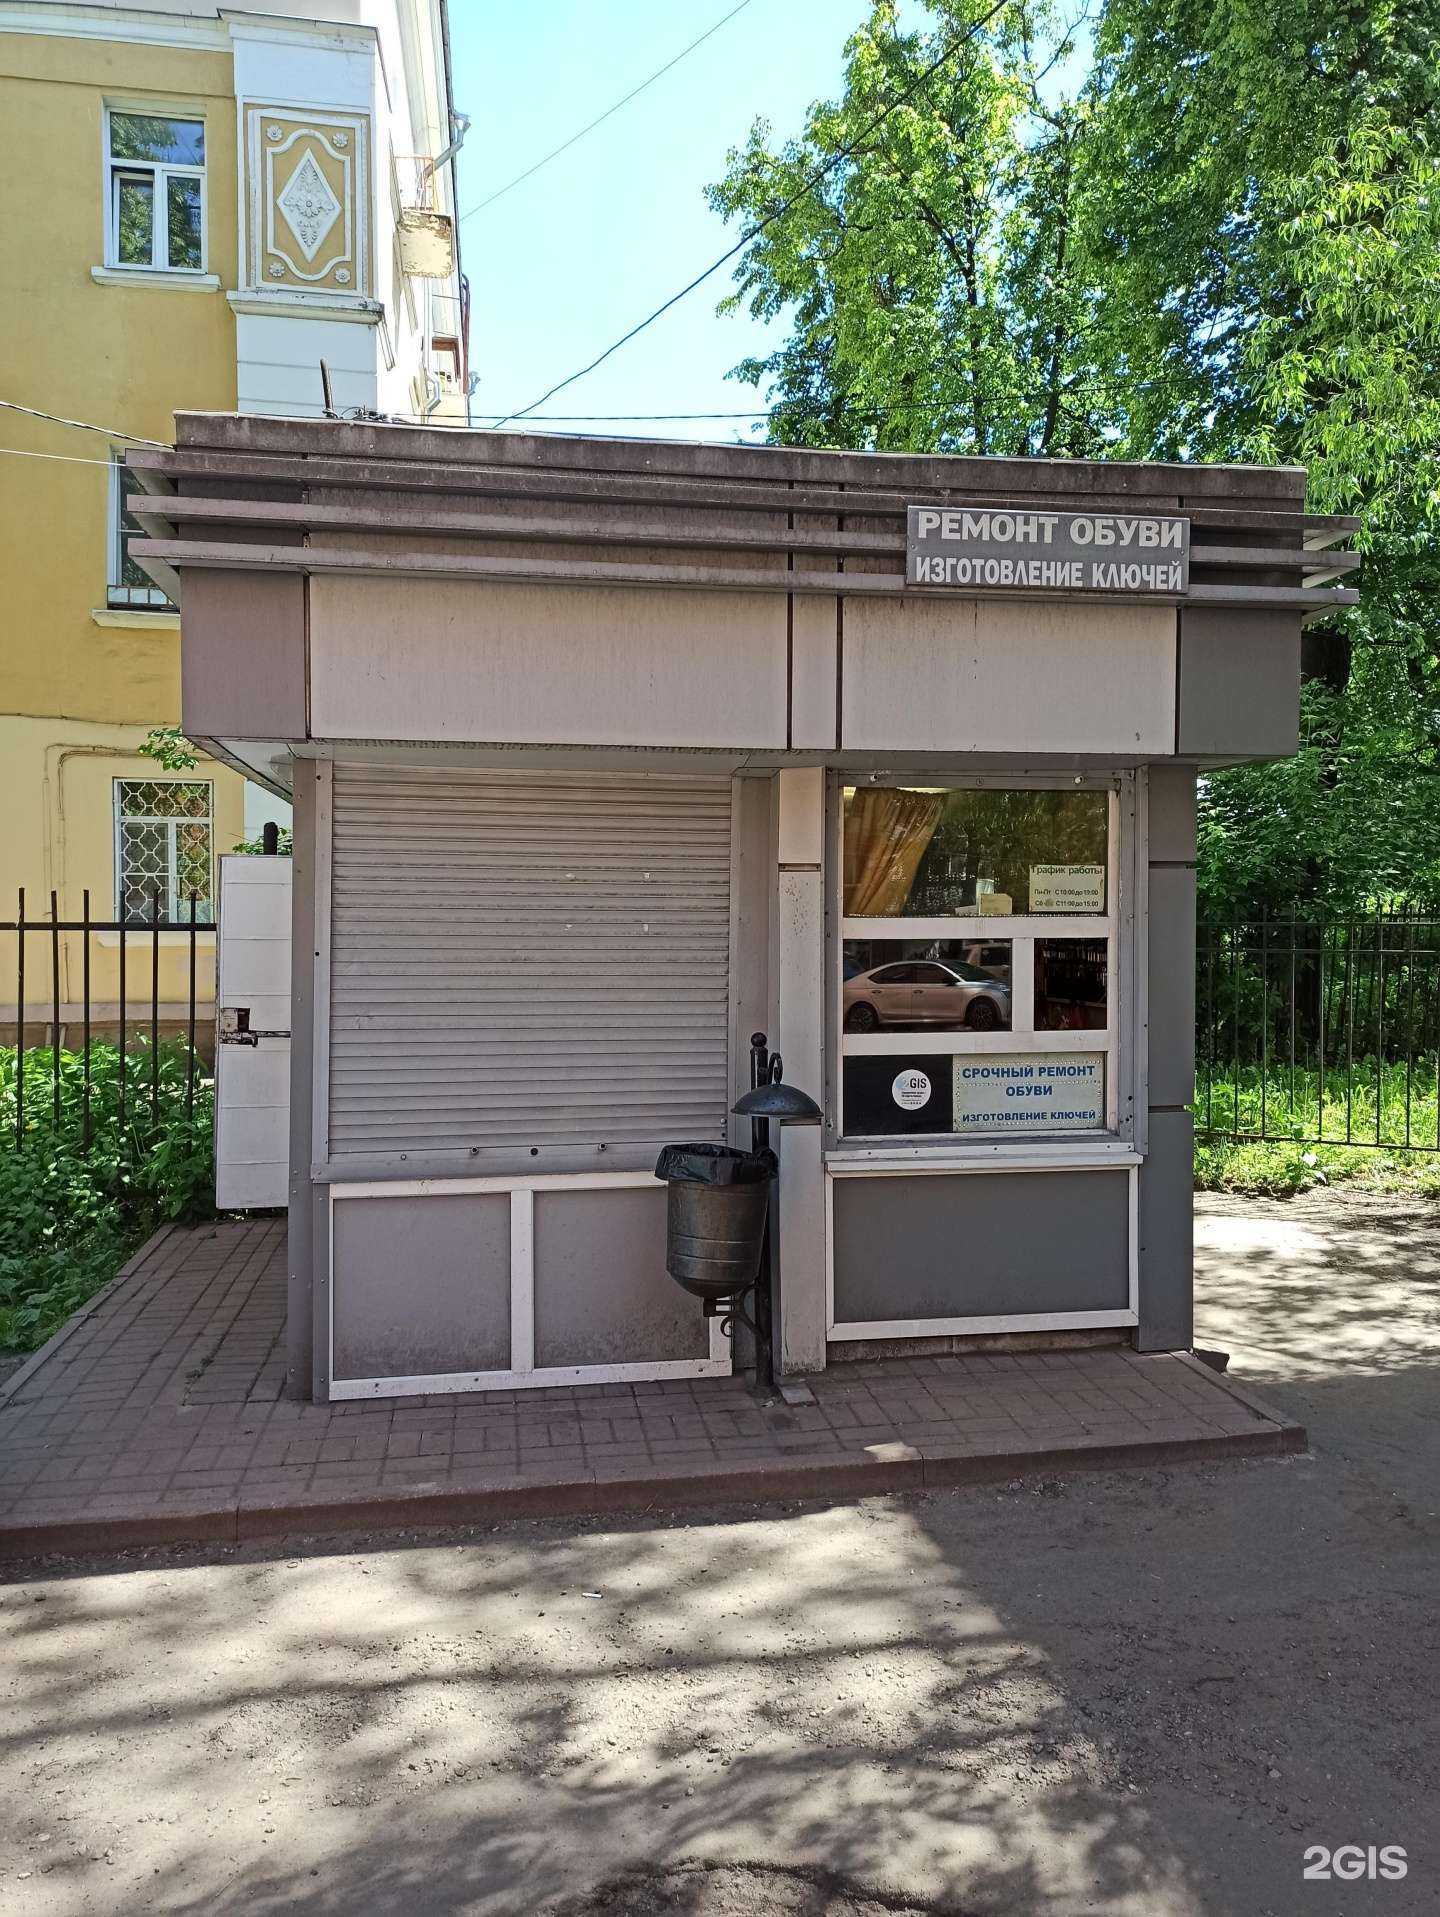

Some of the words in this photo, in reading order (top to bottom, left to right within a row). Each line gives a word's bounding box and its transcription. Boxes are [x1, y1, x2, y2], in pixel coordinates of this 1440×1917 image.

[917, 511, 1058, 544] РЕМОНТ
[1070, 517, 1182, 549] ОБУВИ
[916, 557, 1083, 588] ИЗГОТОВЛЕНИЕ
[1092, 560, 1182, 590] КЛЮЧЕЙ
[1031, 865, 1066, 876] График
[1069, 865, 1103, 876] работы
[962, 1065, 1034, 1079] СРОЧНЫЙ
[1038, 1065, 1095, 1078] РЕМОНТ
[1005, 1085, 1053, 1097] ОБУВИ
[962, 1111, 1047, 1122] ИЗГОТОВЛЕНИЕ
[1050, 1109, 1096, 1120] КЛЮЧЕЙ
